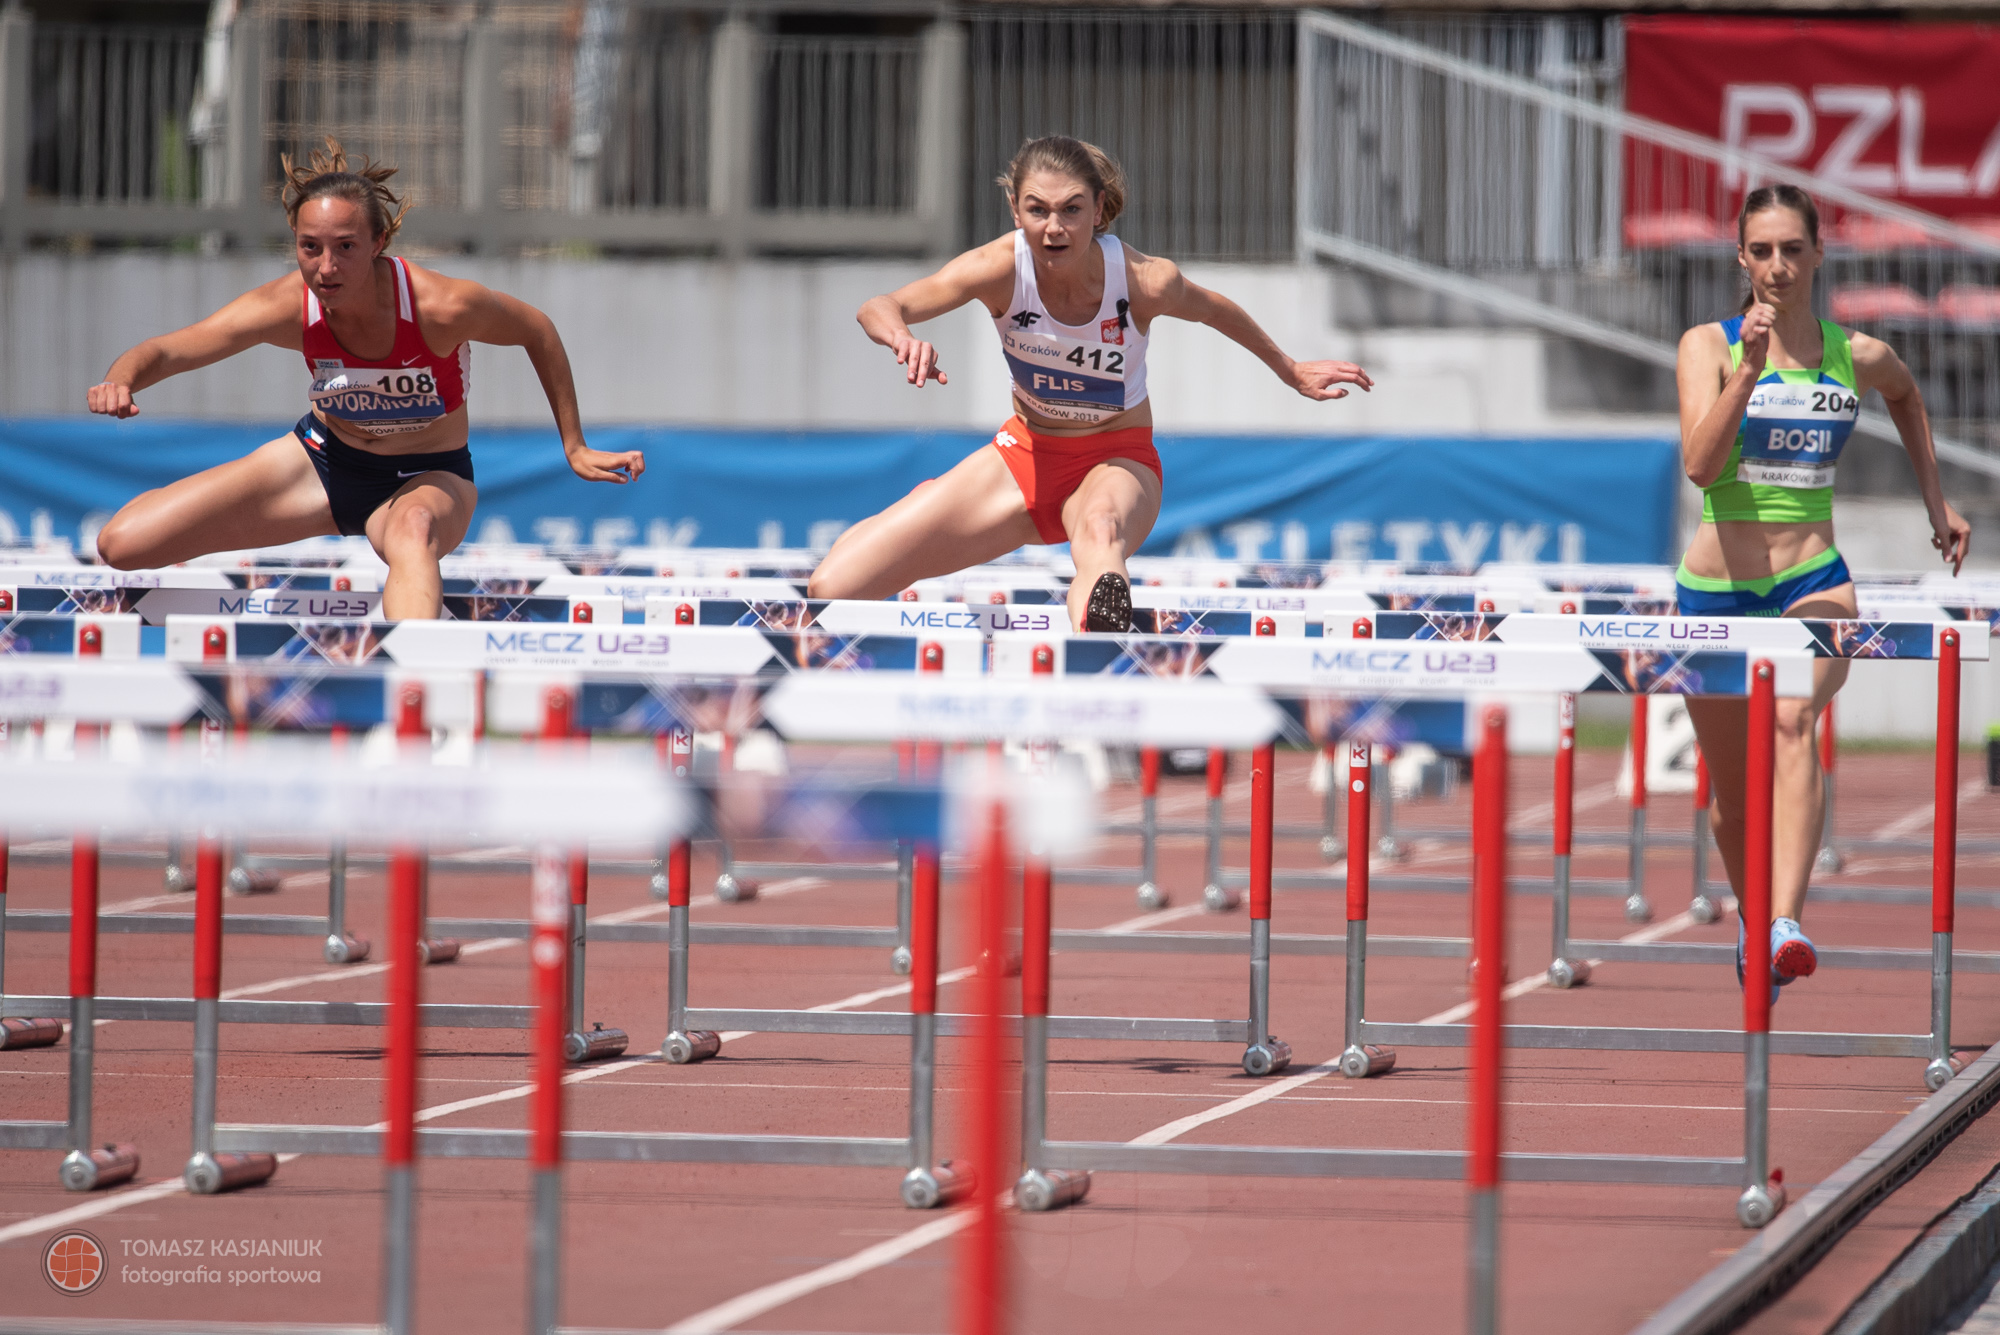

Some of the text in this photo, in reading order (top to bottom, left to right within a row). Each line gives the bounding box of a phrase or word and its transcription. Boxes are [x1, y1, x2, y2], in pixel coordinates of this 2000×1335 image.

[1011, 310, 1042, 328] 4F
[1019, 342, 1124, 374] Kraków 412
[329, 374, 434, 394] Kraków 108
[1032, 373, 1085, 392] FLIS
[1026, 396, 1100, 422] KRAKÓW 2018
[1768, 391, 1856, 413] Kraków 204
[35, 573, 161, 588] MECZ U23
[219, 597, 369, 617] MECZ U23
[1179, 595, 1305, 611] MECZ U23
[900, 610, 1050, 631] MECZ U23
[1579, 621, 1730, 640] MECZ U23
[485, 631, 671, 655] MECZ U23
[1312, 651, 1497, 674] MECZ U23
